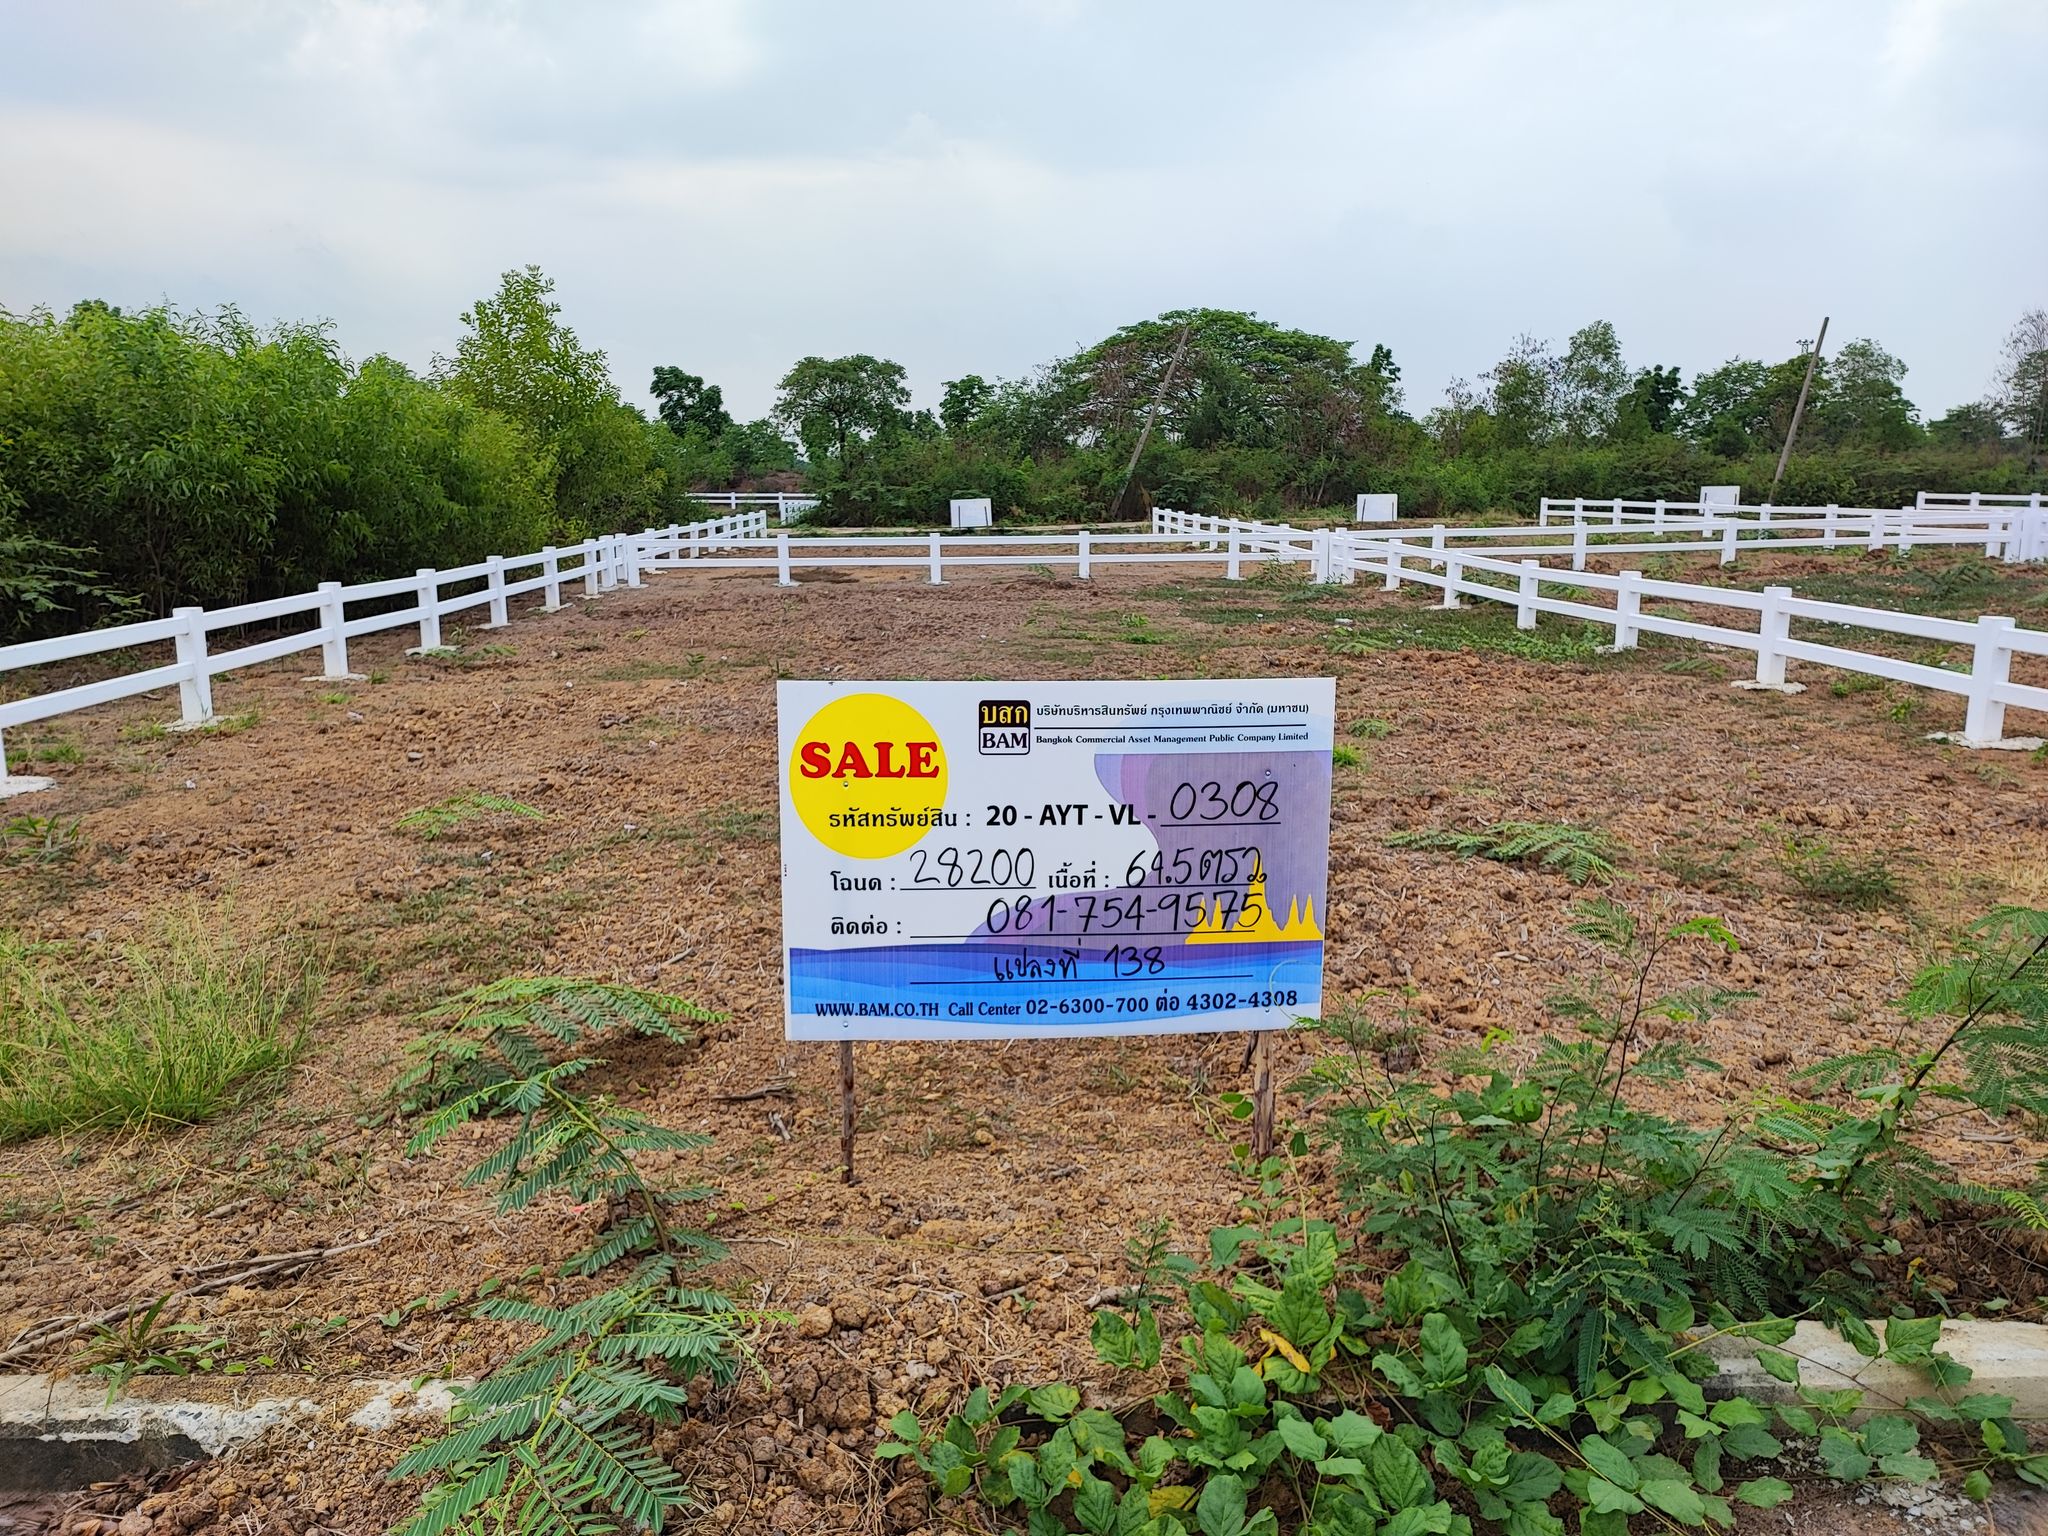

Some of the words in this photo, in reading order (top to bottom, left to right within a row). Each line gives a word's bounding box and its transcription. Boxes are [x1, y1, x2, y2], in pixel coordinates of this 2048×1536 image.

[981, 705, 1028, 725] บสก
[1036, 704, 1147, 717] บริษัทบริหารสินทรัพย์
[1151, 703, 1233, 718] กรุงเทพพาณิชย์
[1236, 702, 1264, 715] จำกัด
[1266, 703, 1309, 716] (มหาชน)
[982, 732, 1028, 749] BAM
[1036, 735, 1073, 745] Bangkok
[1075, 735, 1126, 744] Commercial
[1128, 735, 1151, 744] Asset
[1153, 734, 1207, 745] Management
[1209, 733, 1235, 743] Public
[1237, 733, 1276, 745] Company
[1278, 732, 1309, 741] Limited
[800, 741, 940, 779] SALE
[828, 806, 958, 827] รหัสทรัพย์สิน
[986, 805, 1017, 826] 20
[1039, 804, 1088, 826] AYT
[1109, 804, 1142, 825] VL
[1170, 780, 1280, 820] 0308
[830, 870, 882, 891] โฉนด
[910, 847, 1035, 887] 28200
[1048, 860, 1096, 888] เนื้อที่
[831, 914, 888, 935] ติดต่อ
[987, 889, 1264, 934] 081-754-9575
[994, 938, 1082, 982] แปลงที่
[1104, 943, 1166, 978] 138
[815, 1002, 939, 1018] WWW.BAM.CO.TH
[948, 1001, 973, 1017] Call
[978, 1000, 1021, 1016] Center
[1026, 998, 1149, 1016] 02-6300-700
[1156, 988, 1180, 1013] ต่อ
[1187, 989, 1298, 1010] 4302-4308
